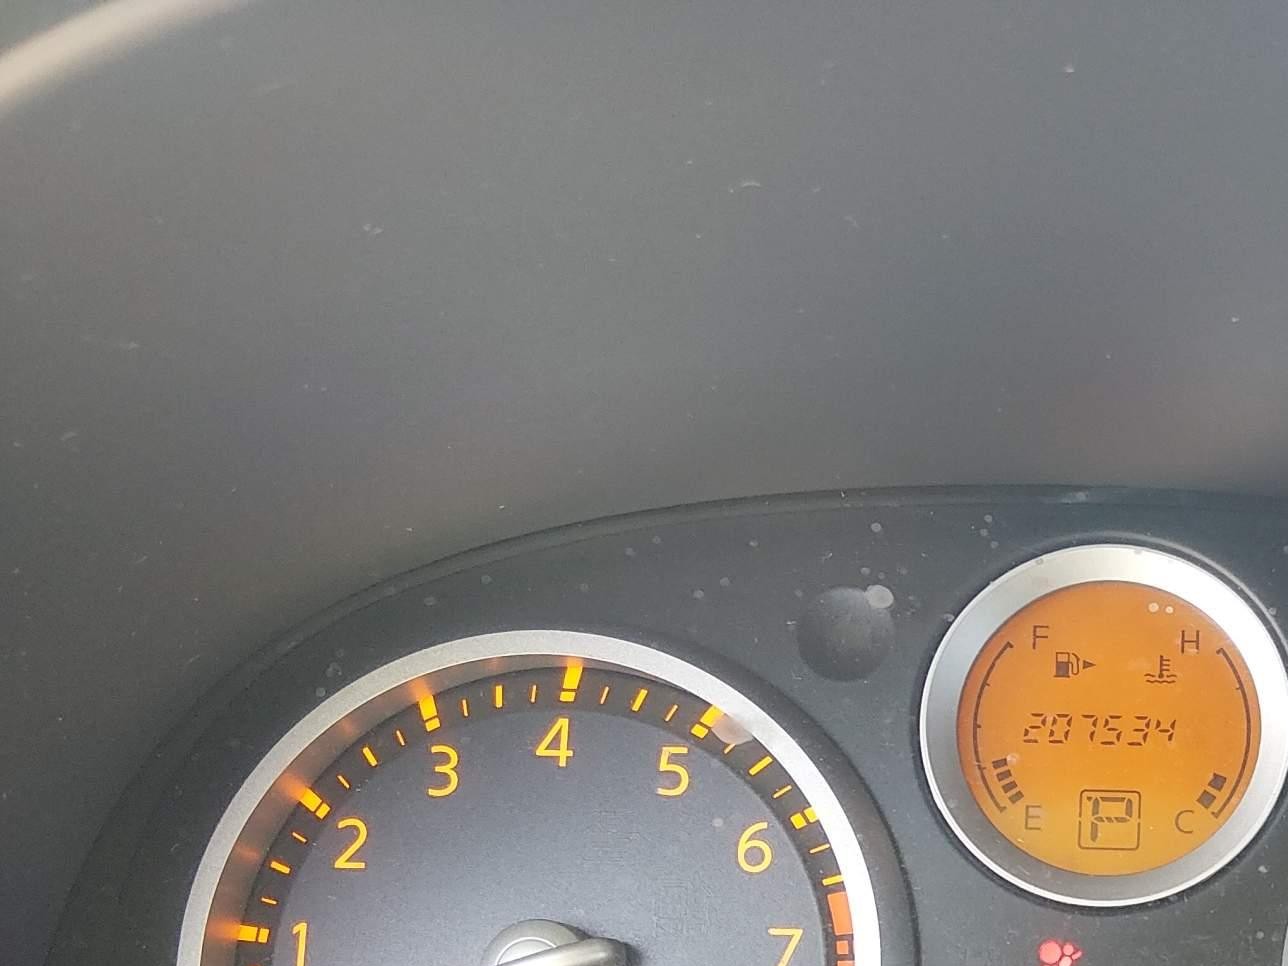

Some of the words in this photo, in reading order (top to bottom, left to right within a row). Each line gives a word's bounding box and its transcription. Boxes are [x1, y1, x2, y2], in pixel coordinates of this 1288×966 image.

[1032, 625, 1050, 650] F
[1181, 630, 1200, 654] H
[535, 717, 574, 767] 4
[1023, 712, 1177, 747] 207534
[427, 745, 459, 796] 3
[656, 746, 690, 796] 5
[1025, 804, 1042, 831] E
[1086, 795, 1134, 843] P
[1174, 809, 1195, 834] C
[333, 818, 368, 870] 2
[737, 821, 773, 873] 6
